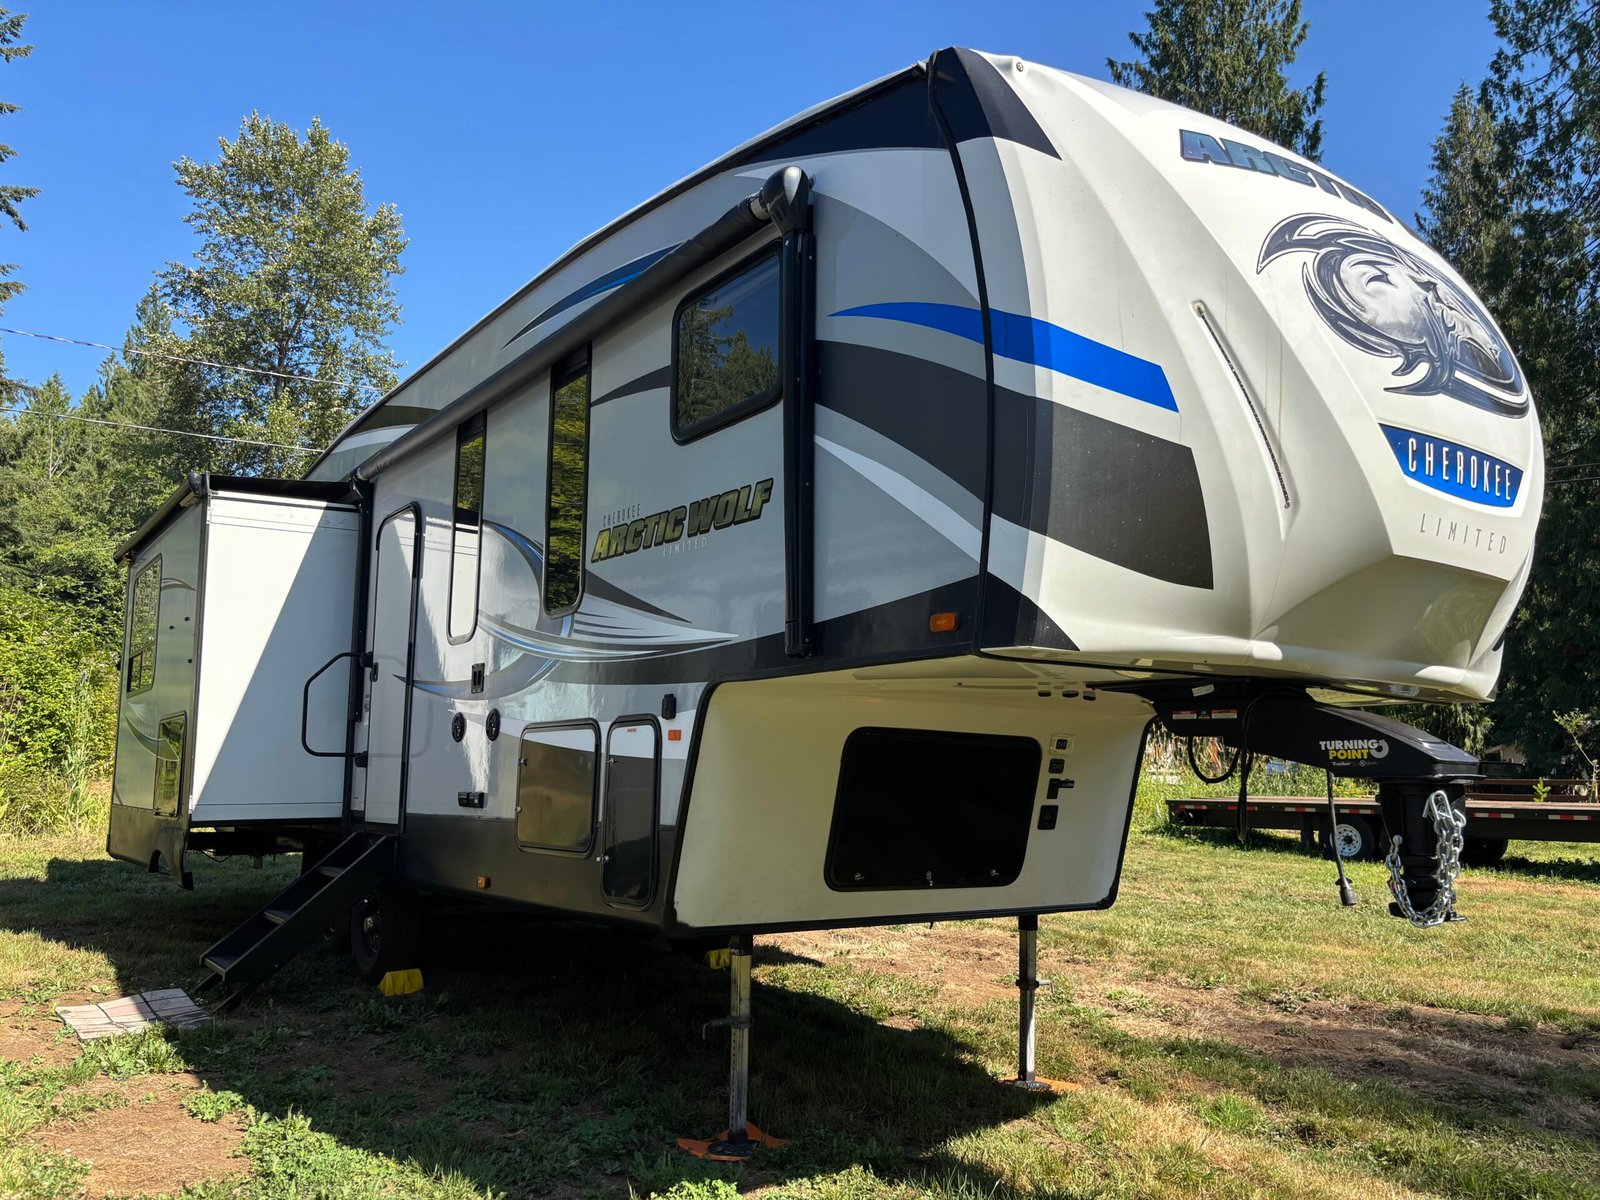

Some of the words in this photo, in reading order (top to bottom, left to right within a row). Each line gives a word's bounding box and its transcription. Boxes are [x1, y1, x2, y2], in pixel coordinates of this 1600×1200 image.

[1408, 437, 1512, 501] CHEROKEE
[591, 505, 687, 563] ARCTIC
[687, 477, 774, 538] WOLF
[602, 503, 641, 528] CHEROKEE
[1419, 512, 1508, 554] LIMITED
[662, 537, 708, 557] LIMITED
[1319, 739, 1379, 751] TURNING
[1328, 749, 1369, 760] POINT
